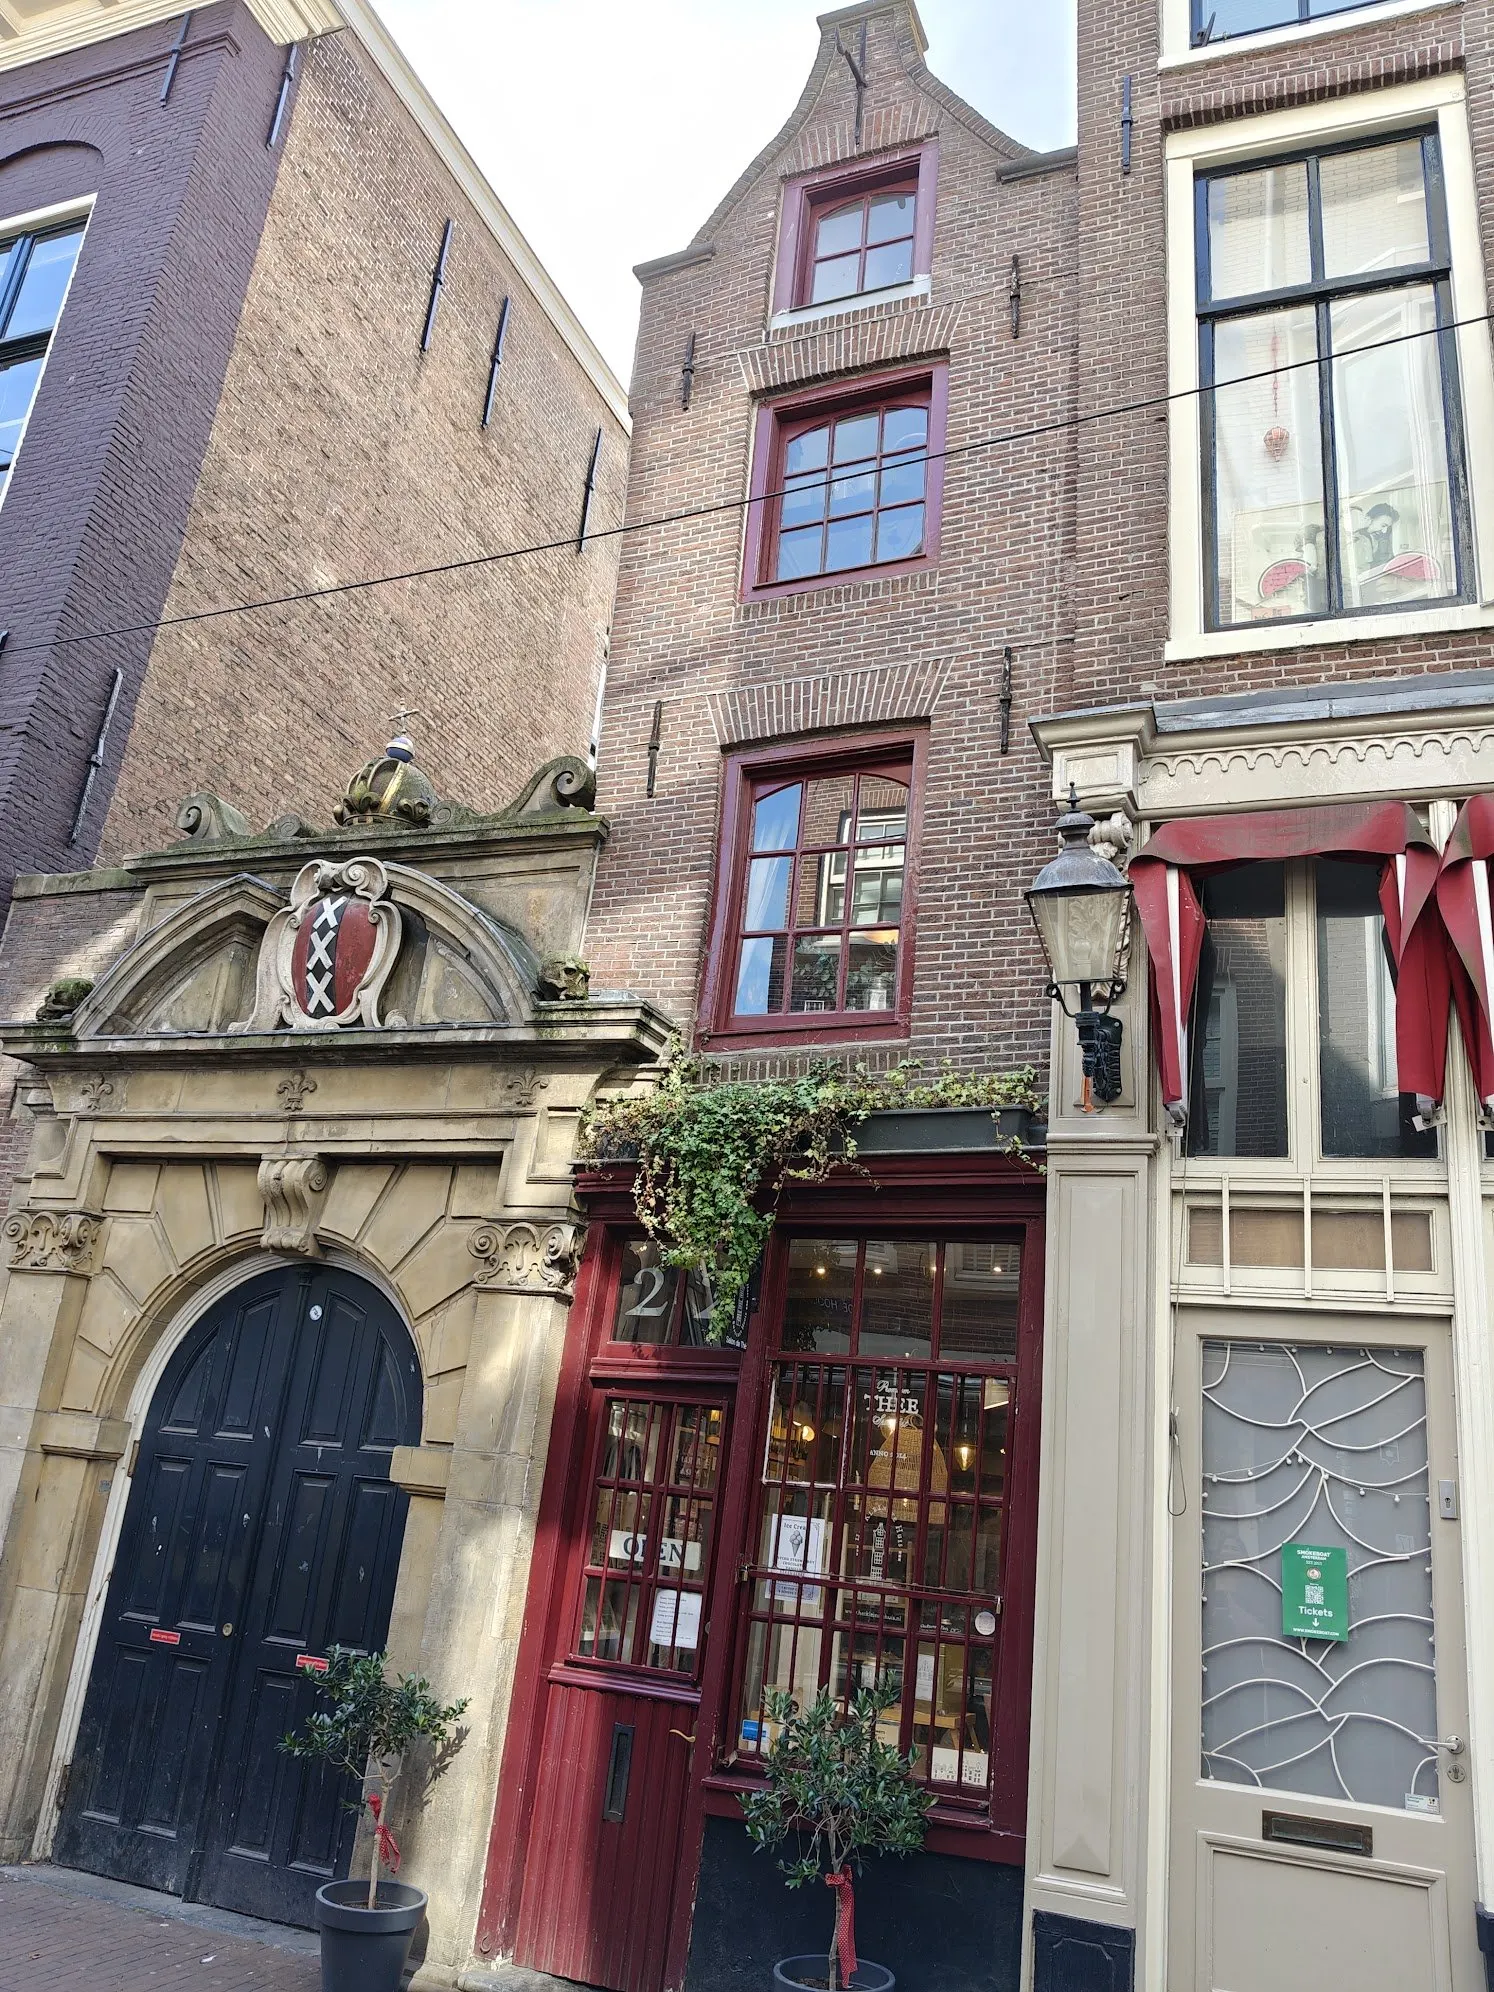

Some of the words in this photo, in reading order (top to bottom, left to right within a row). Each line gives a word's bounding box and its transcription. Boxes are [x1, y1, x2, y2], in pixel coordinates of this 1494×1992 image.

[889, 1451, 908, 1461] 214
[1297, 1550, 1330, 1558] SMOKEBOAT
[1298, 1606, 1333, 1618] Tickets
